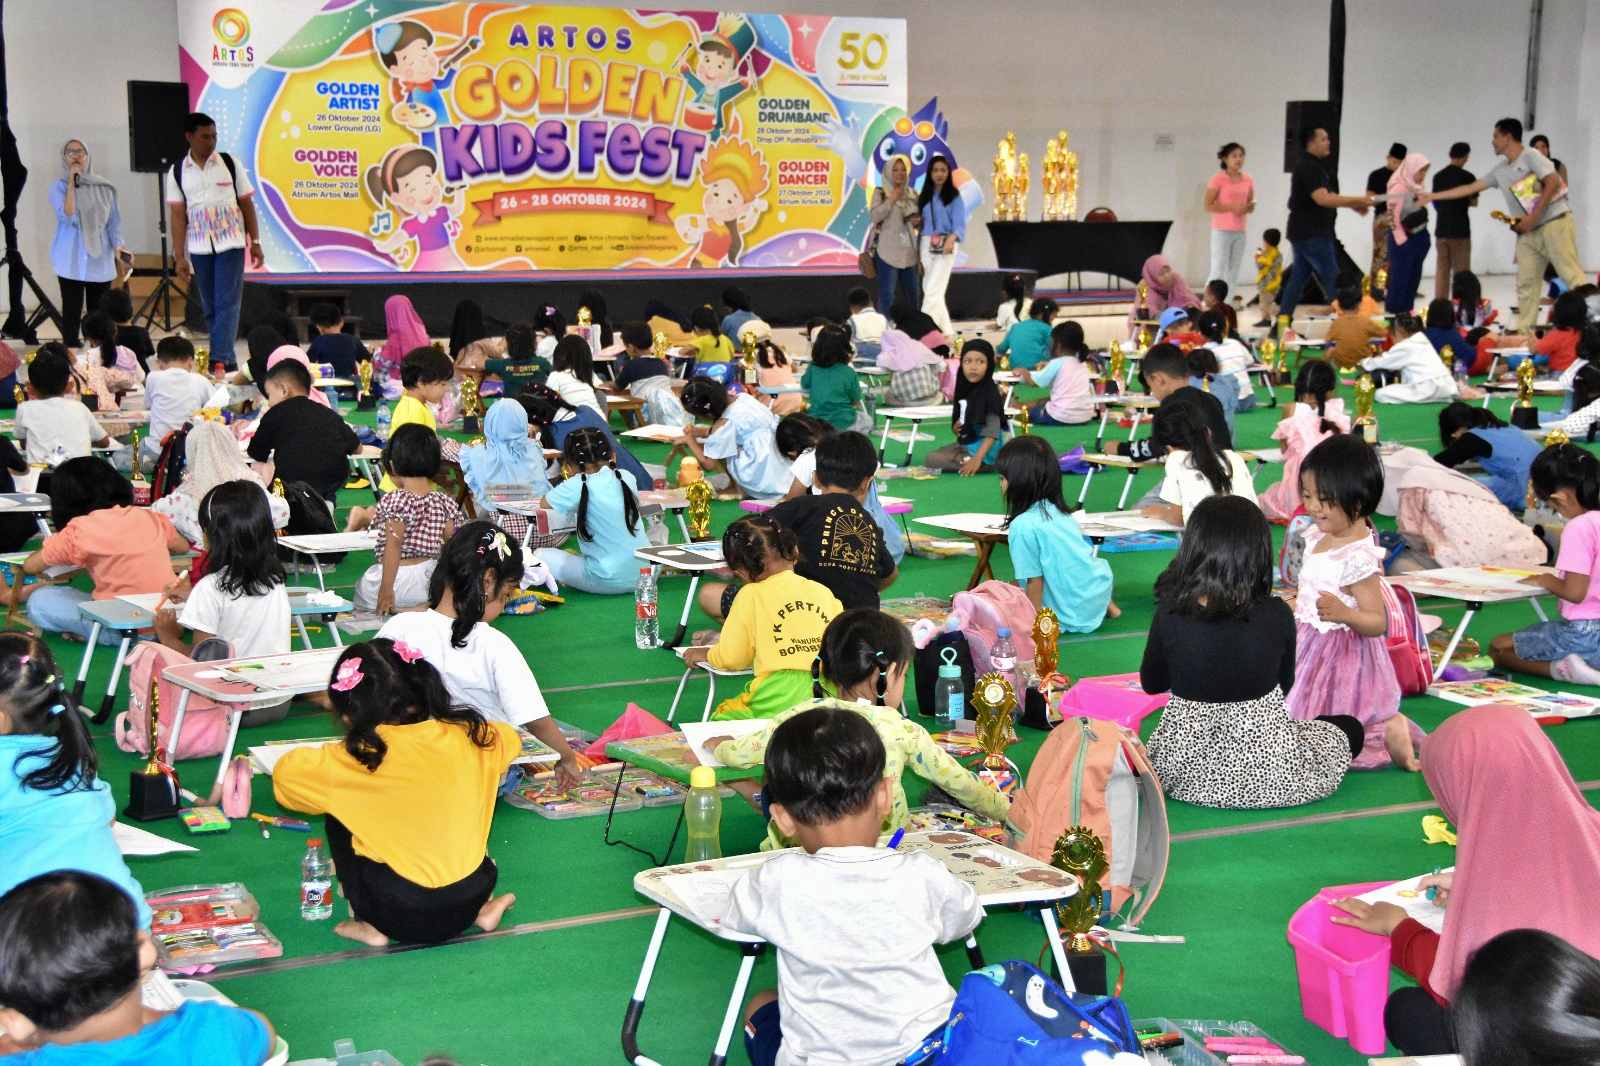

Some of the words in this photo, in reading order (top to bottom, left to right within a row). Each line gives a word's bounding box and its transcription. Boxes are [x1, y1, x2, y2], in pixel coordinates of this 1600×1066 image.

[509, 24, 632, 49] ARTOS
[837, 32, 889, 70] 50
[316, 82, 380, 97] GOLDEN
[454, 55, 683, 123] GOLDEN
[328, 97, 380, 111] ARTIST
[758, 98, 810, 110] GOLDEN
[328, 114, 360, 122] Oktober
[362, 115, 381, 123] 2024
[307, 123, 332, 131] Lower
[334, 124, 363, 132] Ground
[294, 149, 358, 163] GOLDEN
[439, 120, 571, 182] KIDS
[313, 164, 358, 177] VOICE
[778, 161, 830, 173] GOLDEN
[305, 181, 337, 189] Oktober
[778, 174, 828, 185] DANCER
[292, 190, 319, 198] Atrium
[500, 197, 518, 209] 26
[531, 194, 549, 206] 28
[552, 193, 610, 206] OKTOBER
[614, 194, 648, 209] 2024
[773, 623, 783, 643] TK
